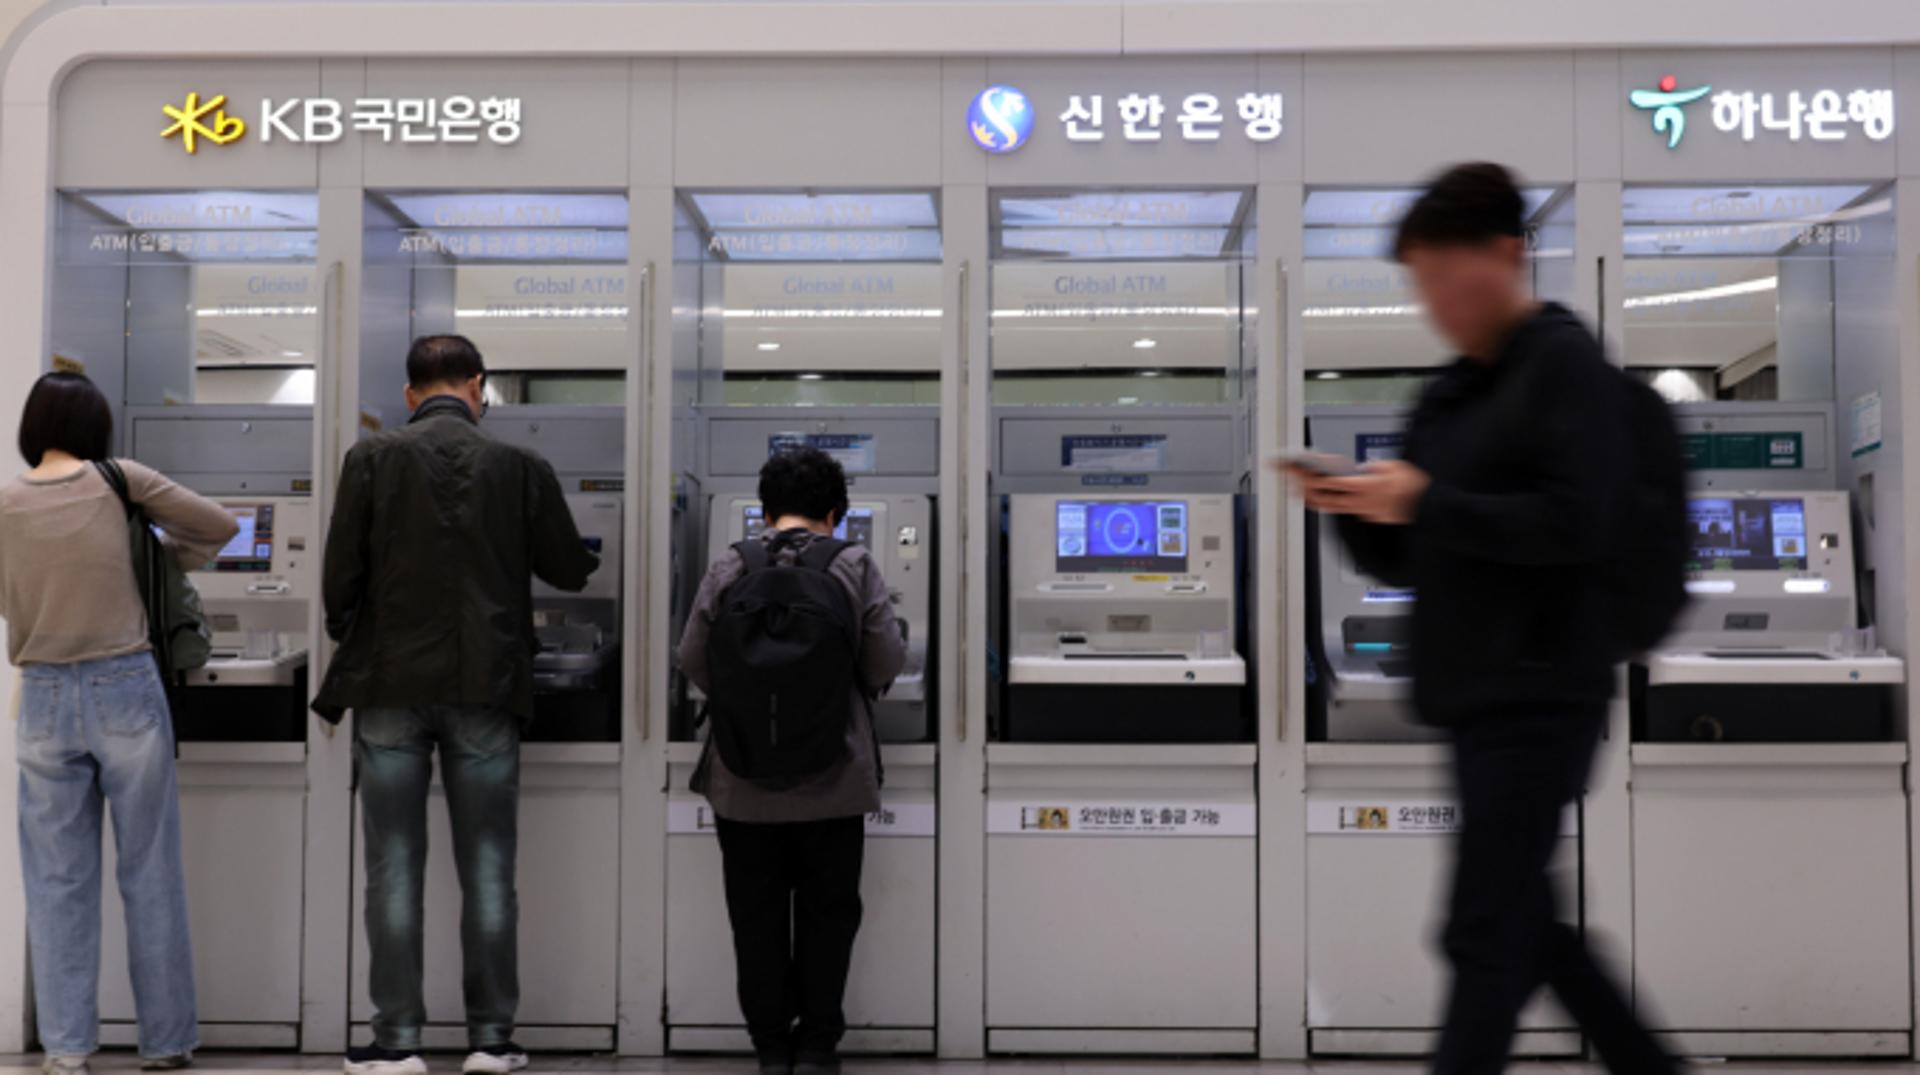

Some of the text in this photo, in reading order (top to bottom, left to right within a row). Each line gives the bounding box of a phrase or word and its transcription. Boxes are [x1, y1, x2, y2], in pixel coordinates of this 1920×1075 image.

[1710, 88, 1894, 141] 하나은행
[126, 205, 252, 225] Global ATM
[434, 206, 561, 226] Global ATM
[744, 205, 873, 225] Global ATM
[1134, 203, 1187, 223] ATM
[1692, 196, 1824, 217] Global ATM
[514, 276, 626, 295] Global ATM
[782, 275, 895, 295] Global ATM
[1054, 275, 1168, 295] Global ATM
